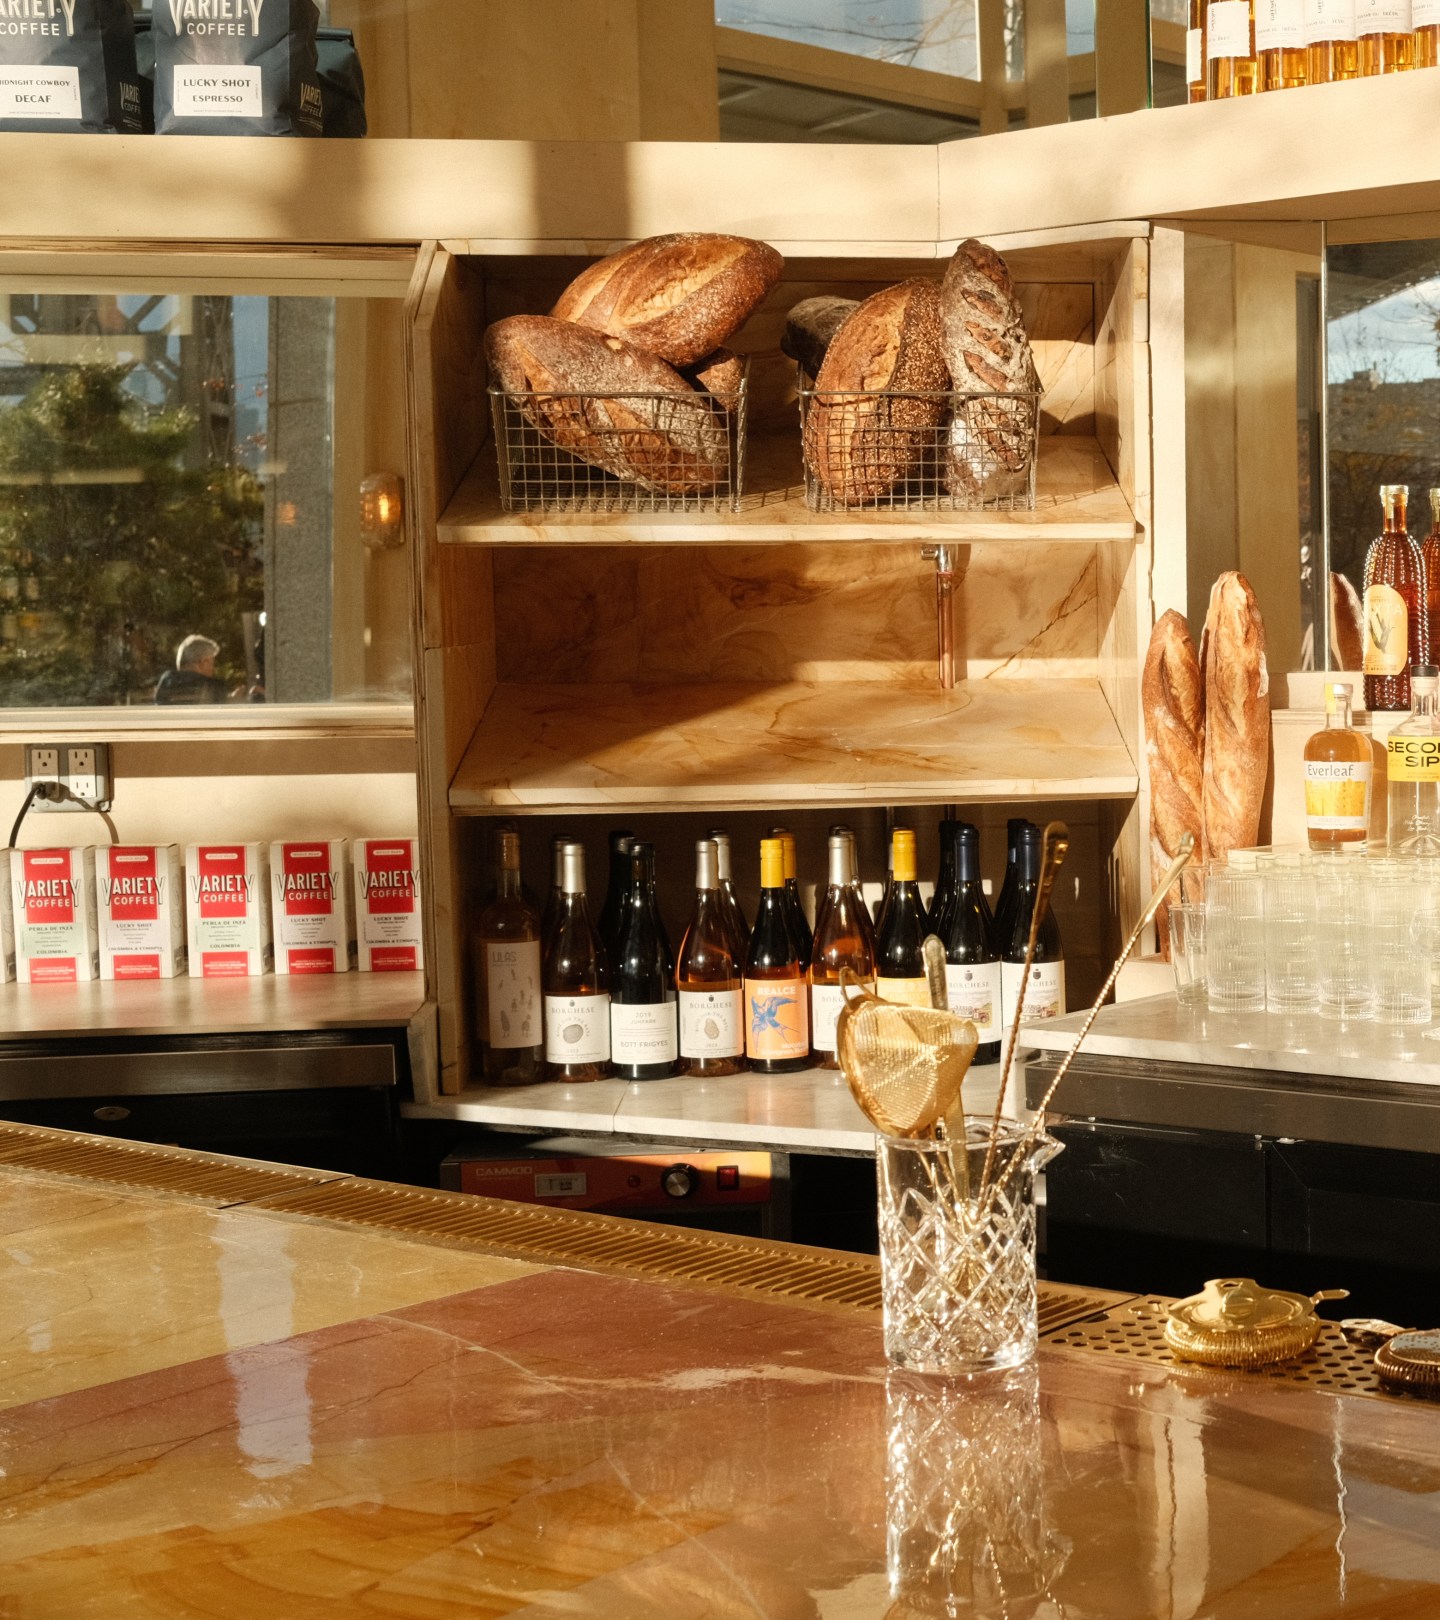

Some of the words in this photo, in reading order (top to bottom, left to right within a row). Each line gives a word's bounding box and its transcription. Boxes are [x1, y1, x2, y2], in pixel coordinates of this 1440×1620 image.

[187, 23, 246, 36] COFFEE
[183, 78, 218, 87] LUCKY
[222, 79, 252, 88] SHOT
[15, 94, 52, 103] DECAF
[192, 95, 243, 103] ESPRESSO
[1405, 755, 1440, 768] SIP
[1307, 764, 1354, 777] Everleaf
[190, 873, 256, 904] VARIETY
[275, 871, 340, 902] VARIETY
[358, 870, 420, 900] VARIETY
[16, 878, 81, 909] VARIETY
[101, 876, 166, 907] VARIETY
[288, 891, 329, 901] COFFEE
[371, 889, 411, 899] COFFEE
[29, 898, 71, 908] COFFEE
[113, 896, 155, 905] COFFEE
[203, 893, 244, 903] COFFEE
[1016, 979, 1056, 988] BRGHESE
[757, 986, 796, 996] REALCE
[551, 1006, 595, 1014] BORGHESE
[689, 1001, 733, 1009] BORGHESE
[621, 1040, 638, 1048] BOTT
[639, 1039, 669, 1048] FRIGYES
